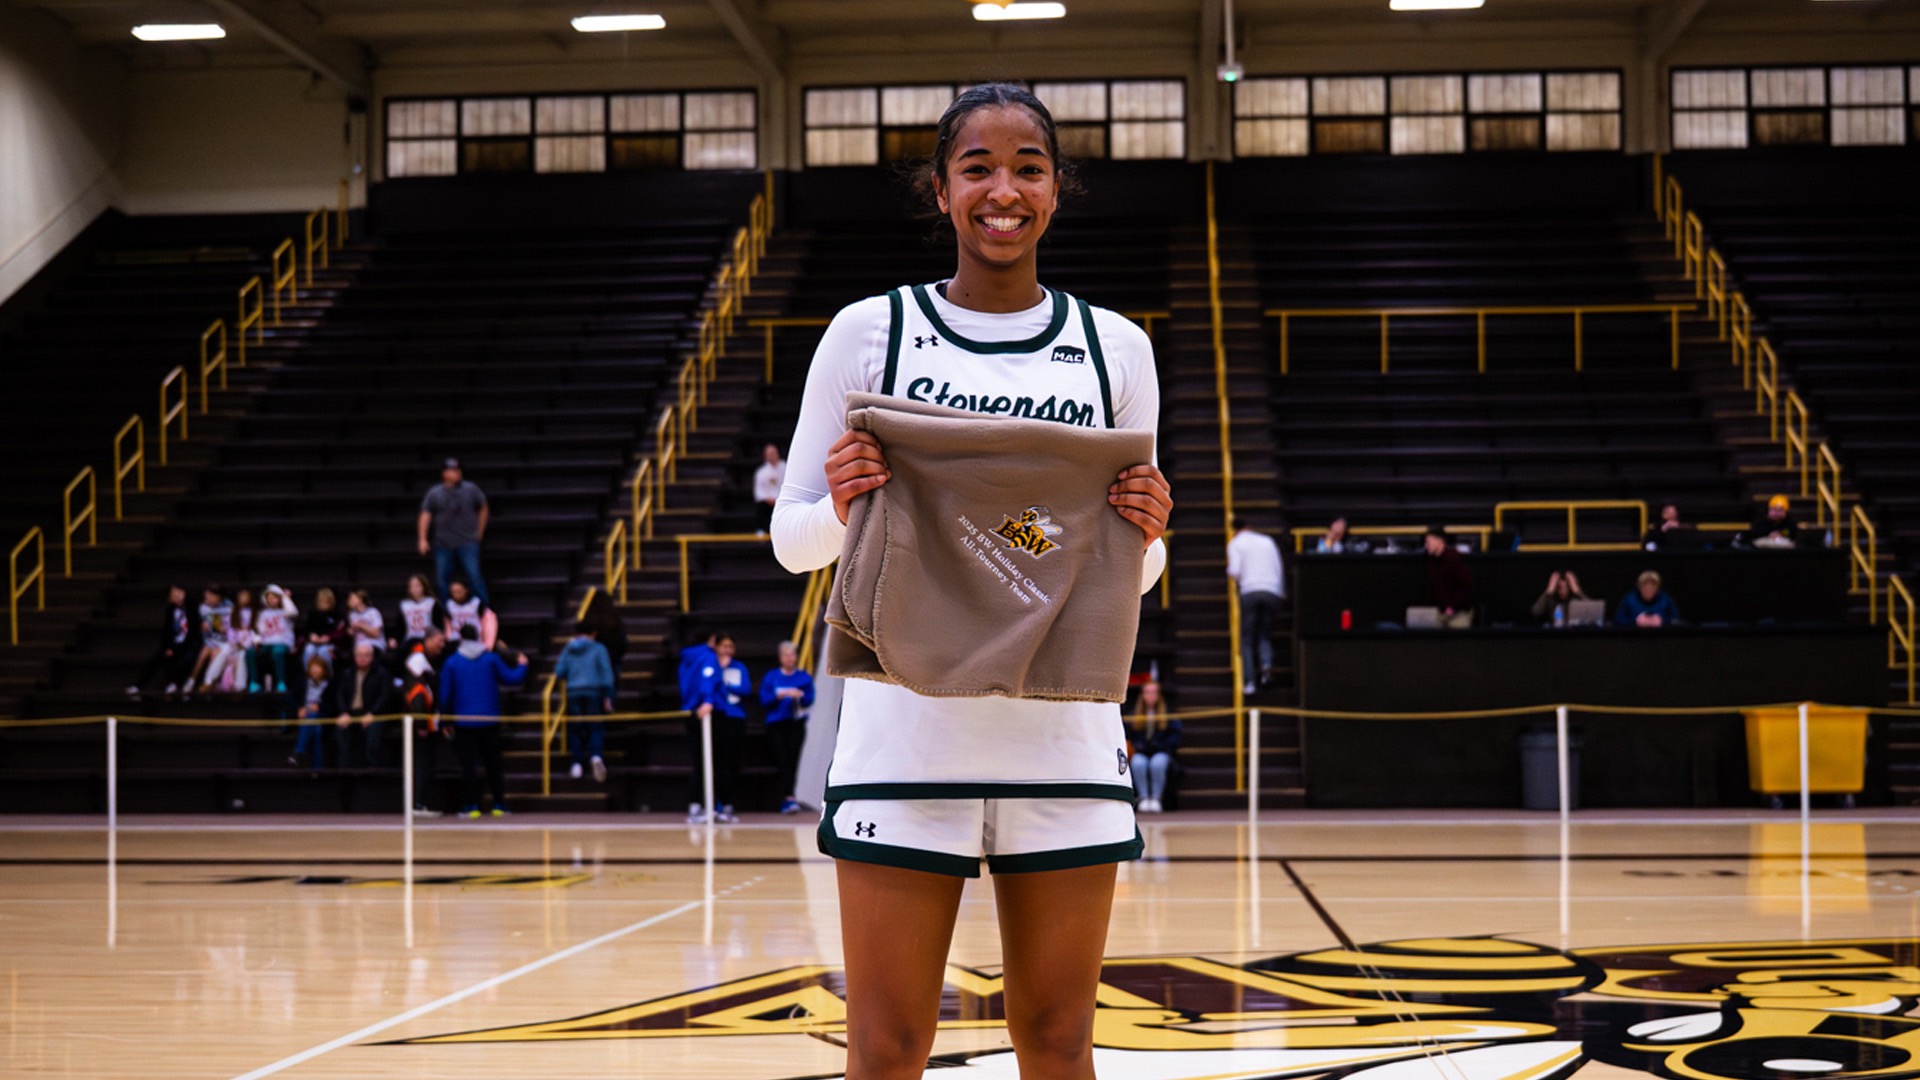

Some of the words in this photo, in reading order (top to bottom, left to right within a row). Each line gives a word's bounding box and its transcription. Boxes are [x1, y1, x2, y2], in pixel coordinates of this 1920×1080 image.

[1053, 351, 1084, 362] MAC
[958, 515, 979, 535] 2025
[976, 533, 995, 548] BW
[992, 548, 1024, 580] Holiday
[1023, 578, 1051, 604] Classic
[960, 535, 1009, 583] All-Tourney
[1009, 581, 1031, 604] Team
